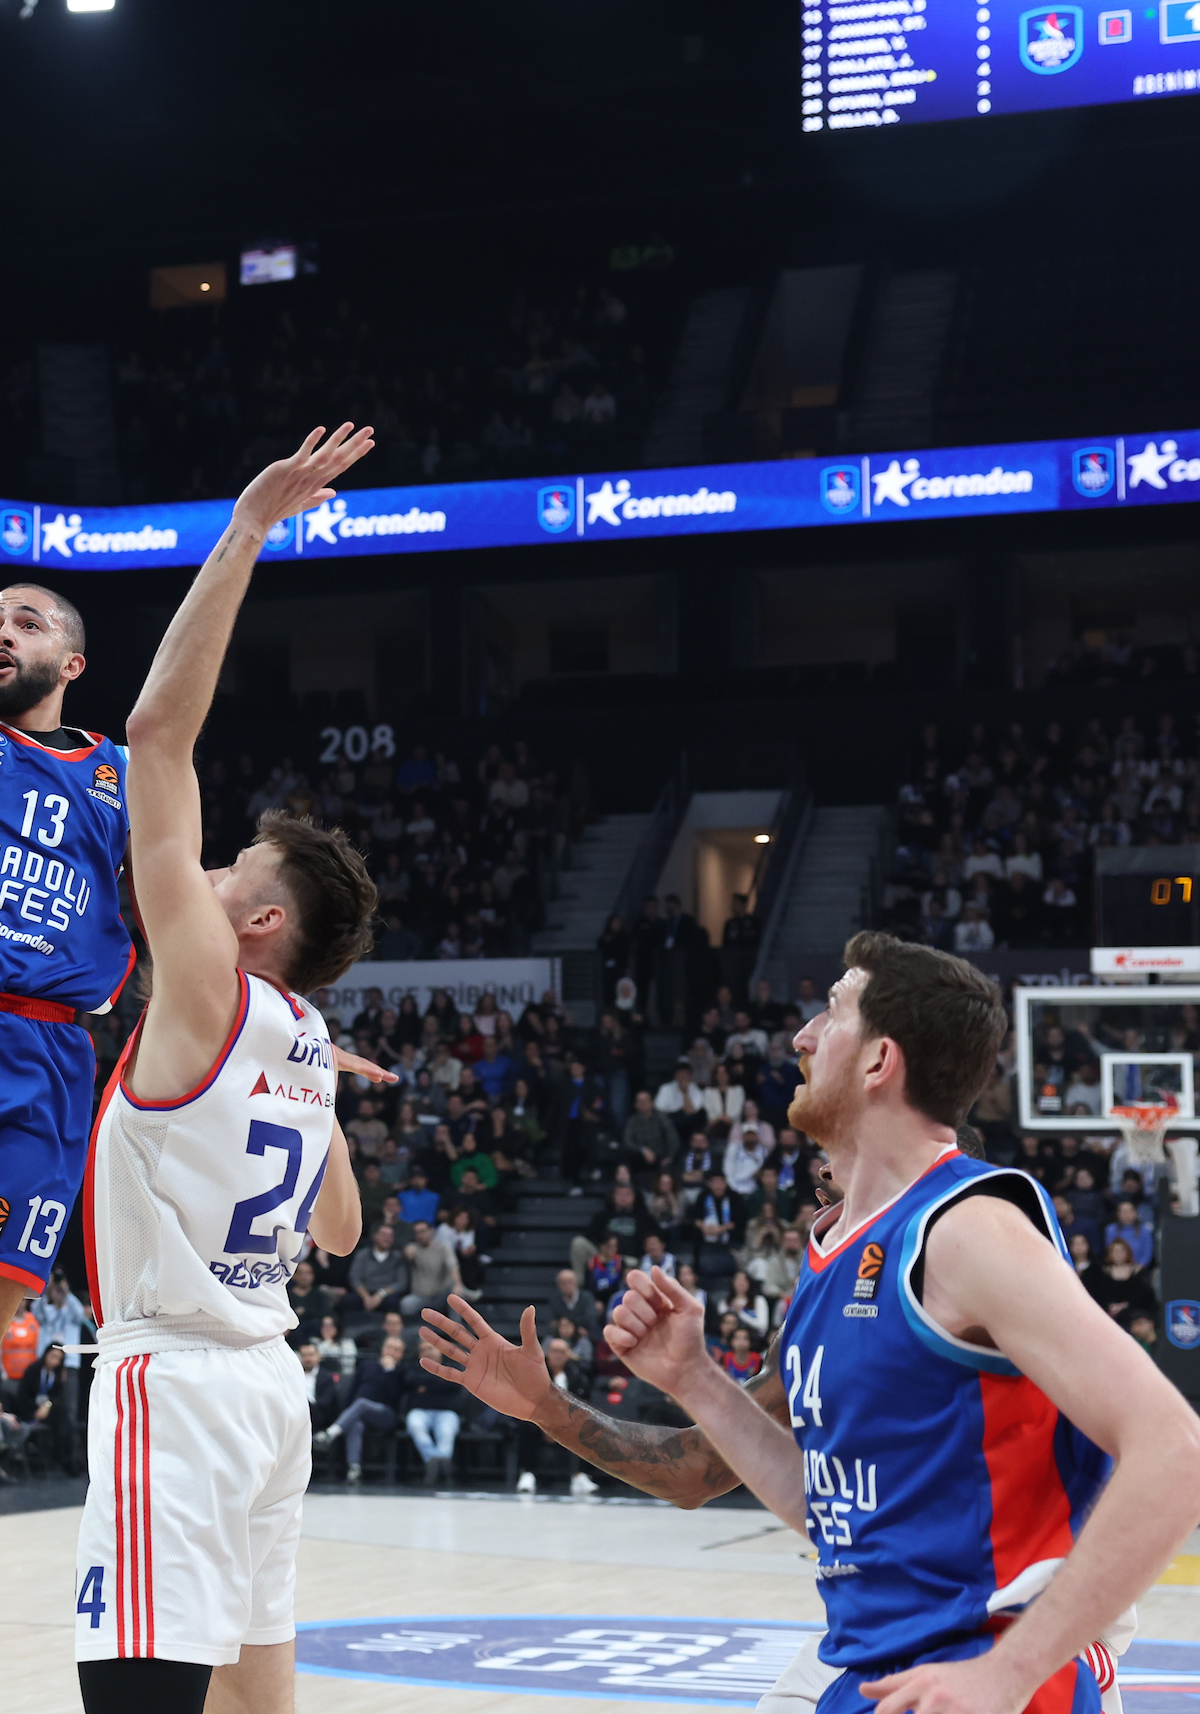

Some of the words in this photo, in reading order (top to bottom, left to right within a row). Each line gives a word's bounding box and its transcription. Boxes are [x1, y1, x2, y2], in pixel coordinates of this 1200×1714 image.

[622, 486, 737, 520] corendon
[910, 466, 1033, 502] corendon
[74, 525, 177, 554] corendon
[338, 506, 446, 536] corendon
[319, 723, 397, 763] 208
[20, 789, 70, 848] 13
[1151, 876, 1193, 906] 07
[17, 1194, 67, 1258] 13
[786, 1344, 825, 1428] 24
[806, 1501, 853, 1546] ES
[75, 1566, 106, 1629] 4
